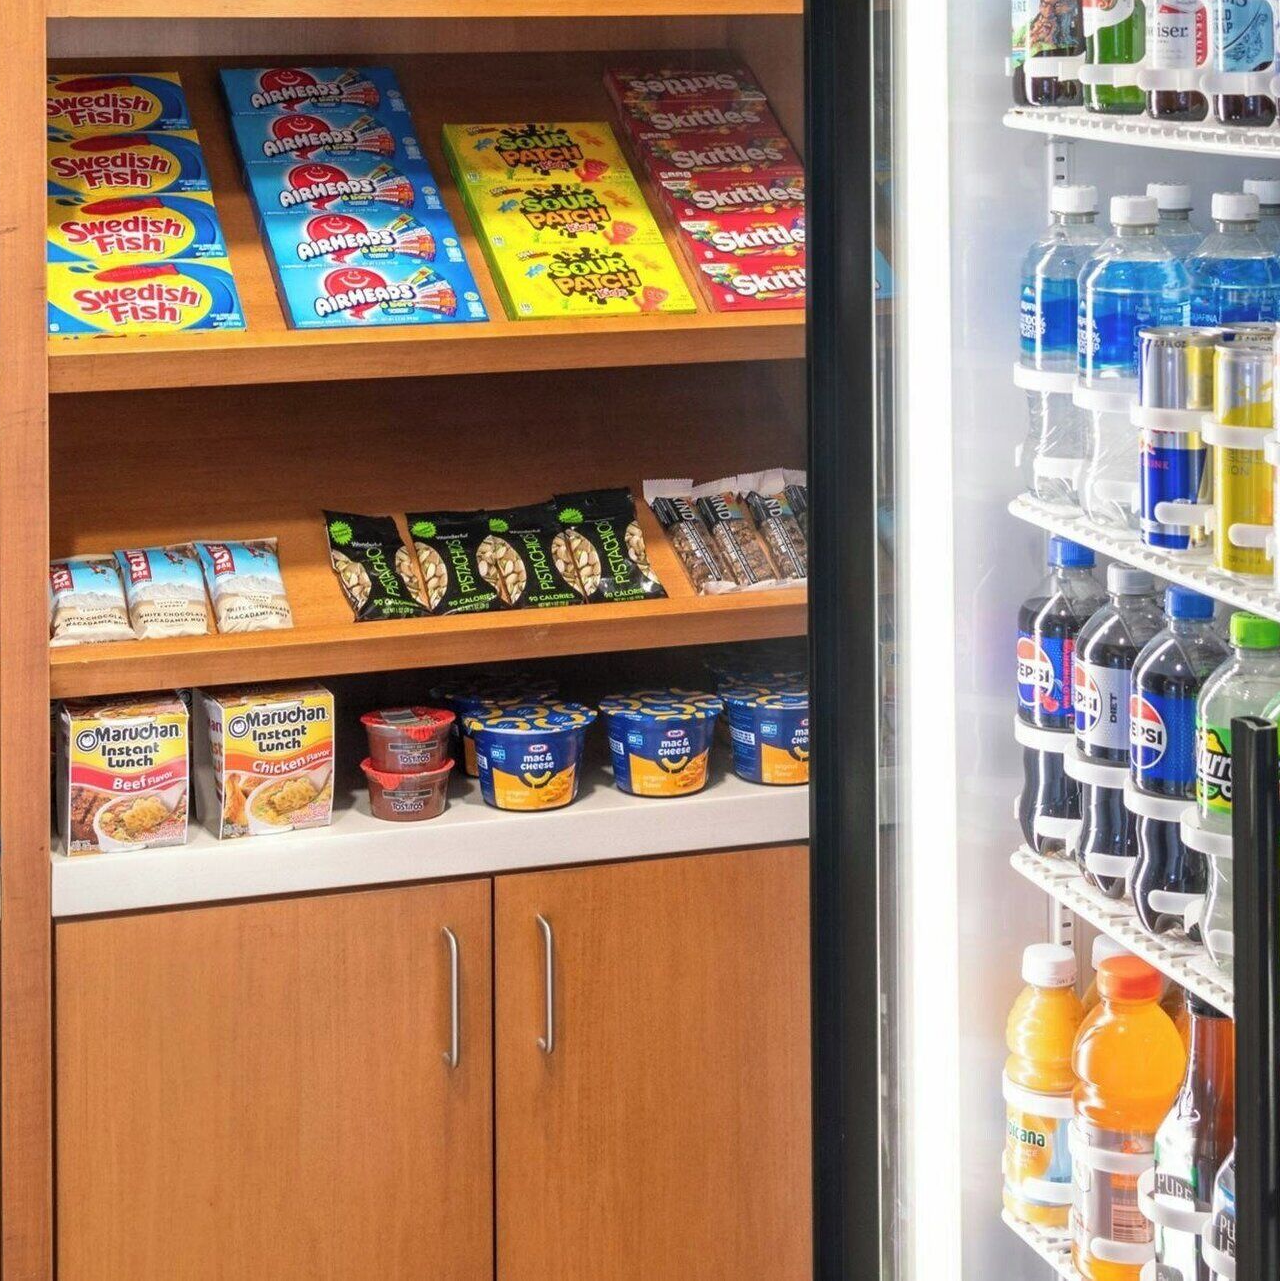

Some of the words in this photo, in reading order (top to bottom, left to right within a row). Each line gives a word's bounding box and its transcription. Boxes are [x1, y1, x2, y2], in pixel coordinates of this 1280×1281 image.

[1195, 13, 1203, 66] GENUIN
[47, 92, 153, 116] Swedish
[251, 82, 344, 109] AIRHEADS
[67, 107, 135, 128] Fish
[650, 107, 761, 132] Skittles
[264, 129, 358, 156] AIRHEADS
[497, 133, 571, 151] SOUR
[51, 153, 171, 176] Swedish
[500, 146, 584, 166] PATCH
[673, 144, 784, 169] Skittles
[80, 164, 152, 187] Fish
[279, 179, 377, 208] AIRHEADS
[521, 195, 598, 212] SOUR
[60, 216, 185, 241] Swedish
[524, 209, 611, 229] PATCH
[98, 232, 167, 254] Fish
[548, 258, 630, 276] SOUR
[551, 273, 641, 293] PATCH
[105, 302, 181, 324] Fish
[459, 594, 496, 604] CALORIES
[540, 593, 575, 601] CALORIES
[1019, 663, 1050, 682] EPSI
[245, 705, 328, 727] Maruchan
[1110, 694, 1118, 723] DIET
[95, 722, 180, 740] Maruchan
[252, 724, 307, 741] Instant
[1131, 723, 1163, 745] EPSI
[101, 742, 160, 757] Instant
[258, 737, 301, 752] Lunch
[108, 754, 153, 768] Lunch
[252, 756, 306, 775] Chicken
[306, 748, 331, 763] Flavor
[112, 776, 147, 791] Beef
[148, 771, 174, 785] Flavor
[1155, 1174, 1193, 1201] PURE
